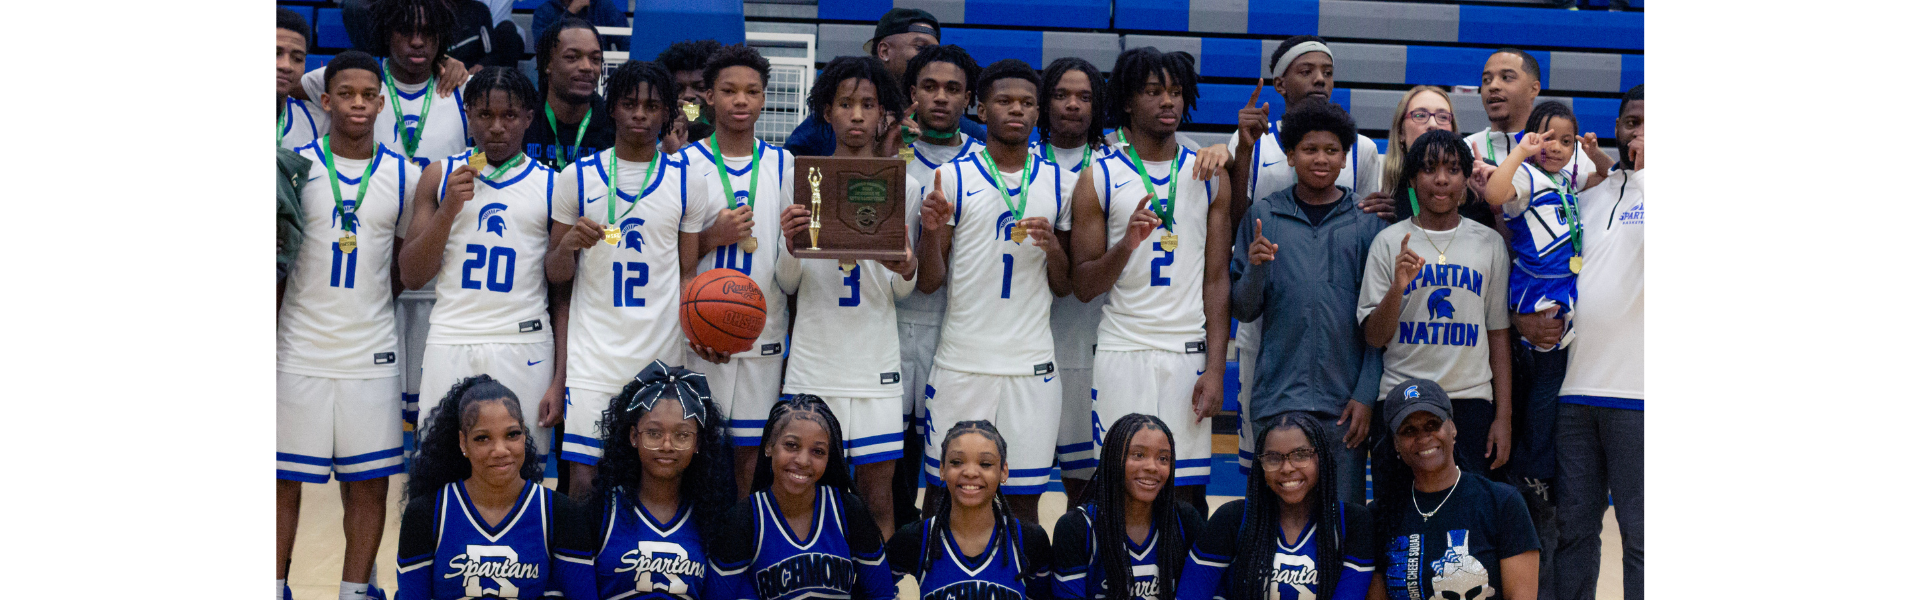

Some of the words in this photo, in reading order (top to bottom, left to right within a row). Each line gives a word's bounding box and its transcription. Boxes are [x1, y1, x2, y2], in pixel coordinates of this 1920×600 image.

[330, 242, 358, 289] 11
[461, 243, 517, 293] 20
[612, 261, 649, 307] 12
[838, 262, 861, 307] 3
[1001, 253, 1014, 299] 1
[1150, 242, 1175, 287] 2
[722, 280, 763, 301] Rawling
[1398, 321, 1479, 347] NATION
[614, 549, 705, 581] Spartans
[635, 540, 689, 594] R
[1409, 533, 1420, 556] SQUAD
[443, 553, 539, 588] Spartans
[465, 544, 519, 598] R
[756, 552, 853, 600] RICHMOND
[924, 580, 1022, 600] CHMO
[1258, 565, 1319, 594] parta
[1407, 557, 1419, 580] CHEER
